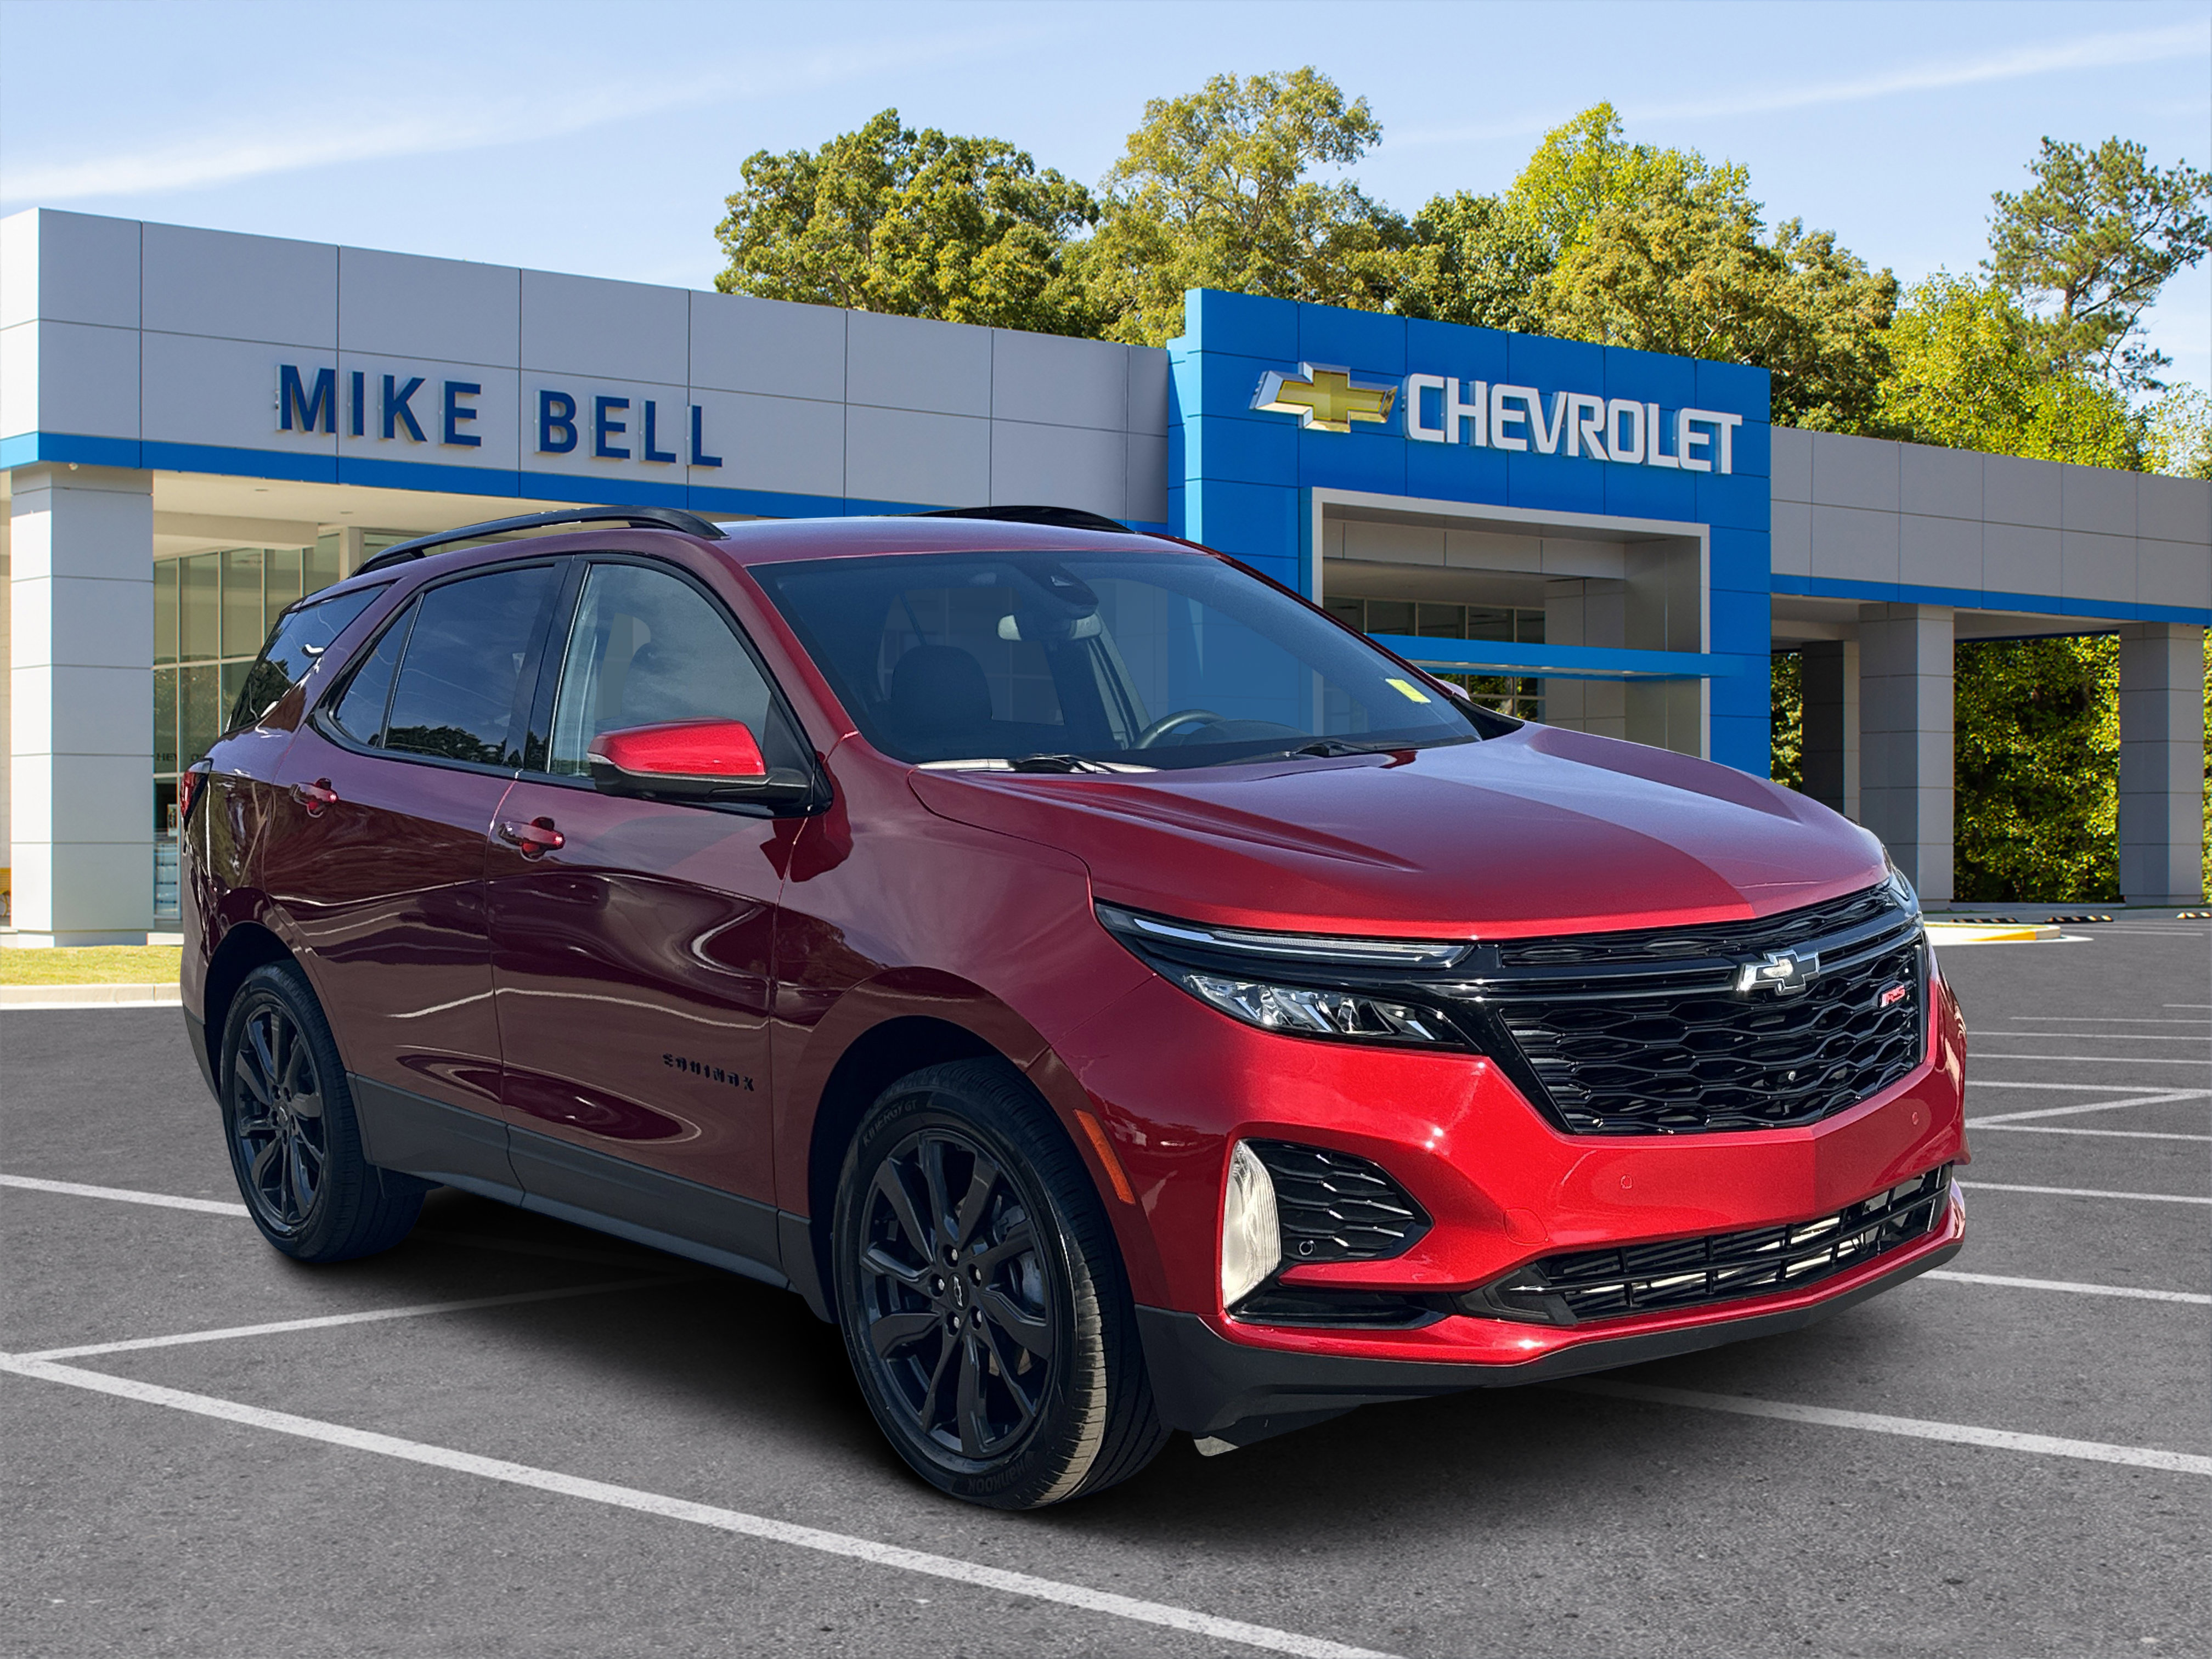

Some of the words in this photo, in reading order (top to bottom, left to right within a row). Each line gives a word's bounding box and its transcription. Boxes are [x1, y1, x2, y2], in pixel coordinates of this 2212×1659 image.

[276, 364, 482, 447] MIKE
[534, 390, 723, 468] BELL
[1404, 374, 1742, 475] CHEVROLET
[1880, 985, 1905, 1008] RS
[663, 1053, 754, 1092] EQUINOX
